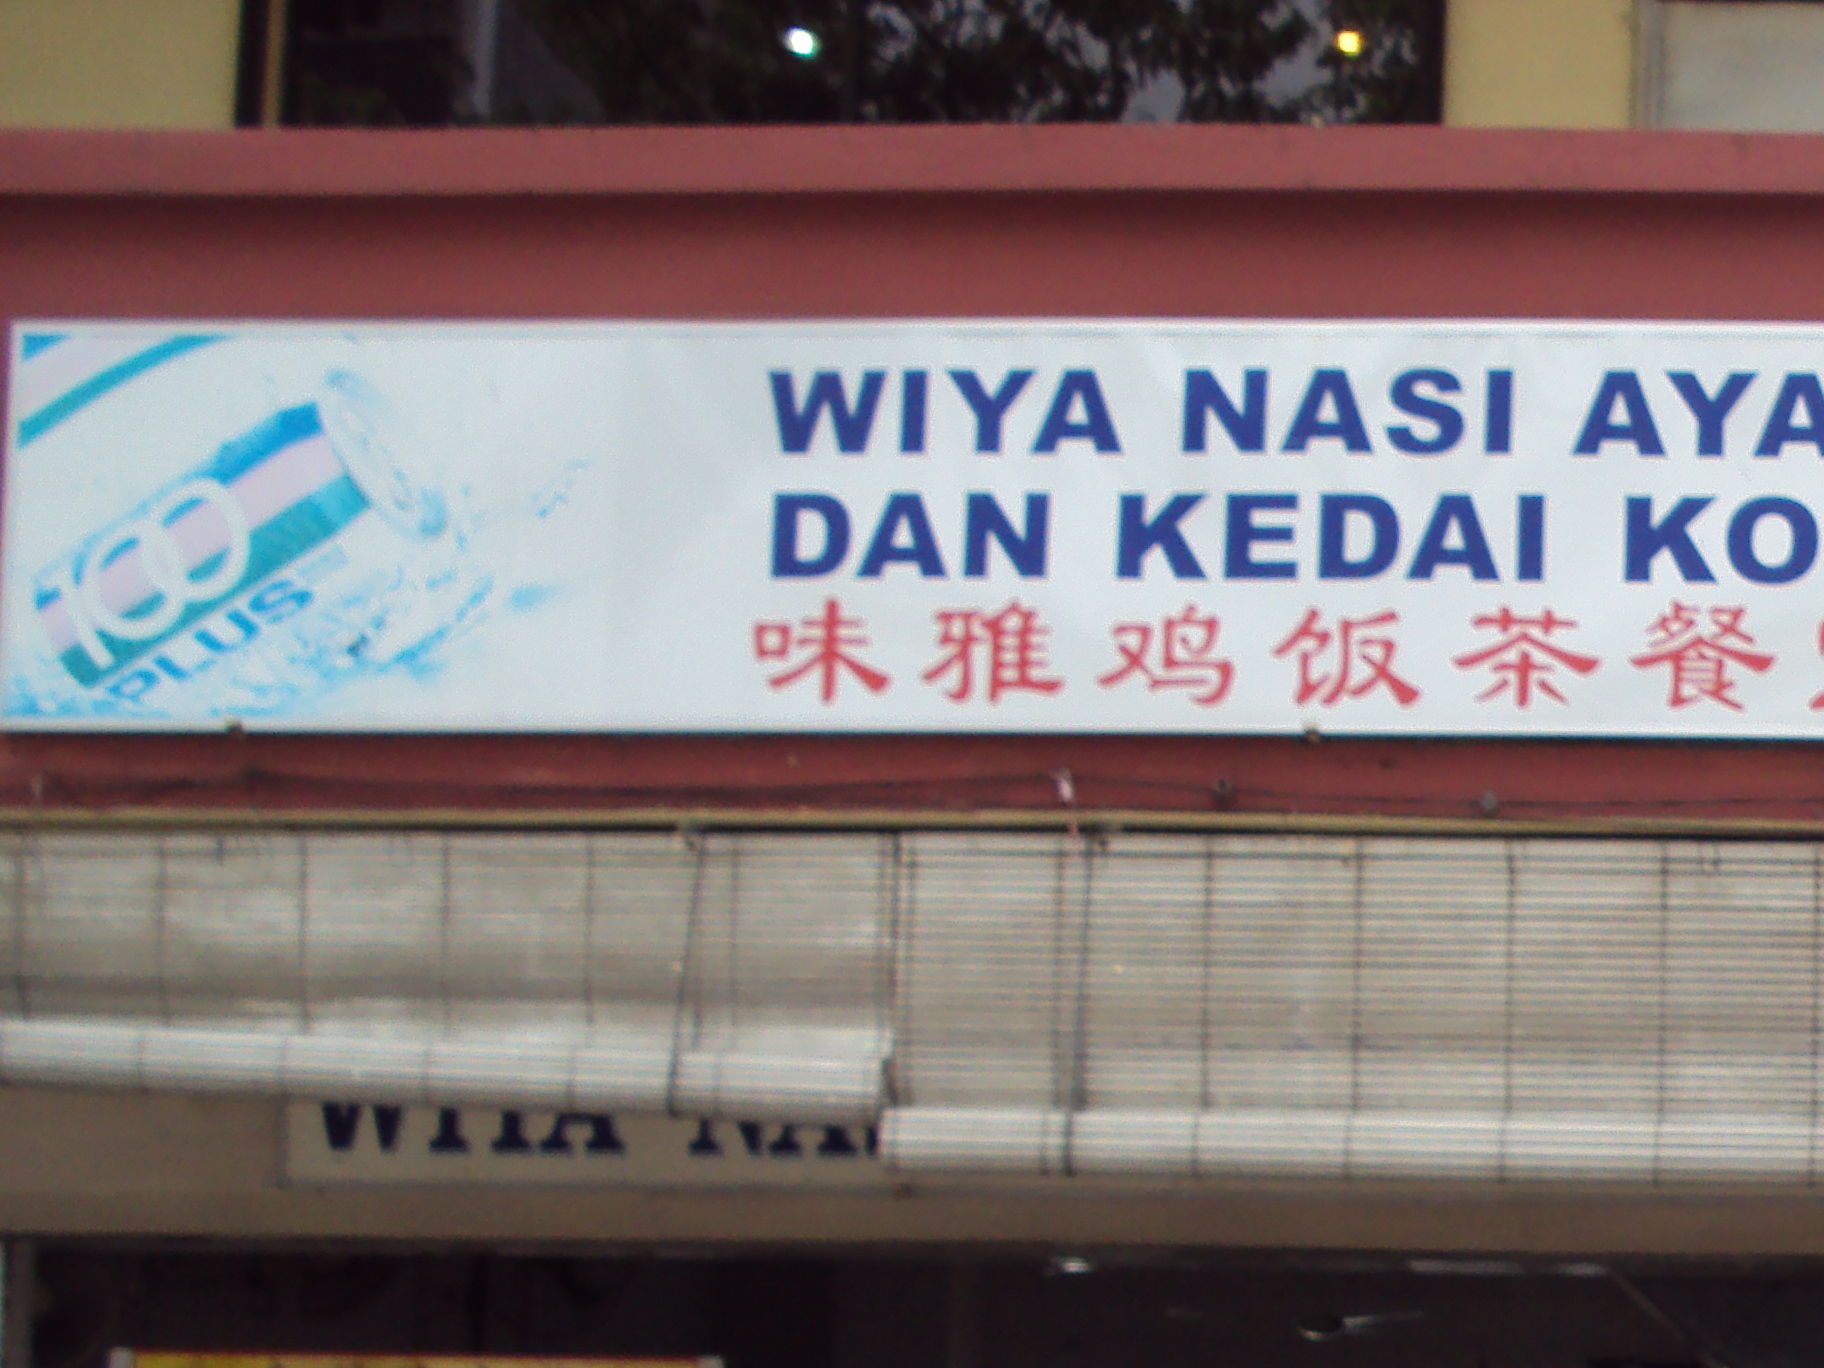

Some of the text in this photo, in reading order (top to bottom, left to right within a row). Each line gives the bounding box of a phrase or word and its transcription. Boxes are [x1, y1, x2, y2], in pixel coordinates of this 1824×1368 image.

[772, 370, 1121, 454] WIYA
[1183, 370, 1513, 455] NASI
[773, 494, 1049, 579] DAN
[1119, 495, 1545, 581] KEDAI
[105, 578, 314, 704] PLUS
